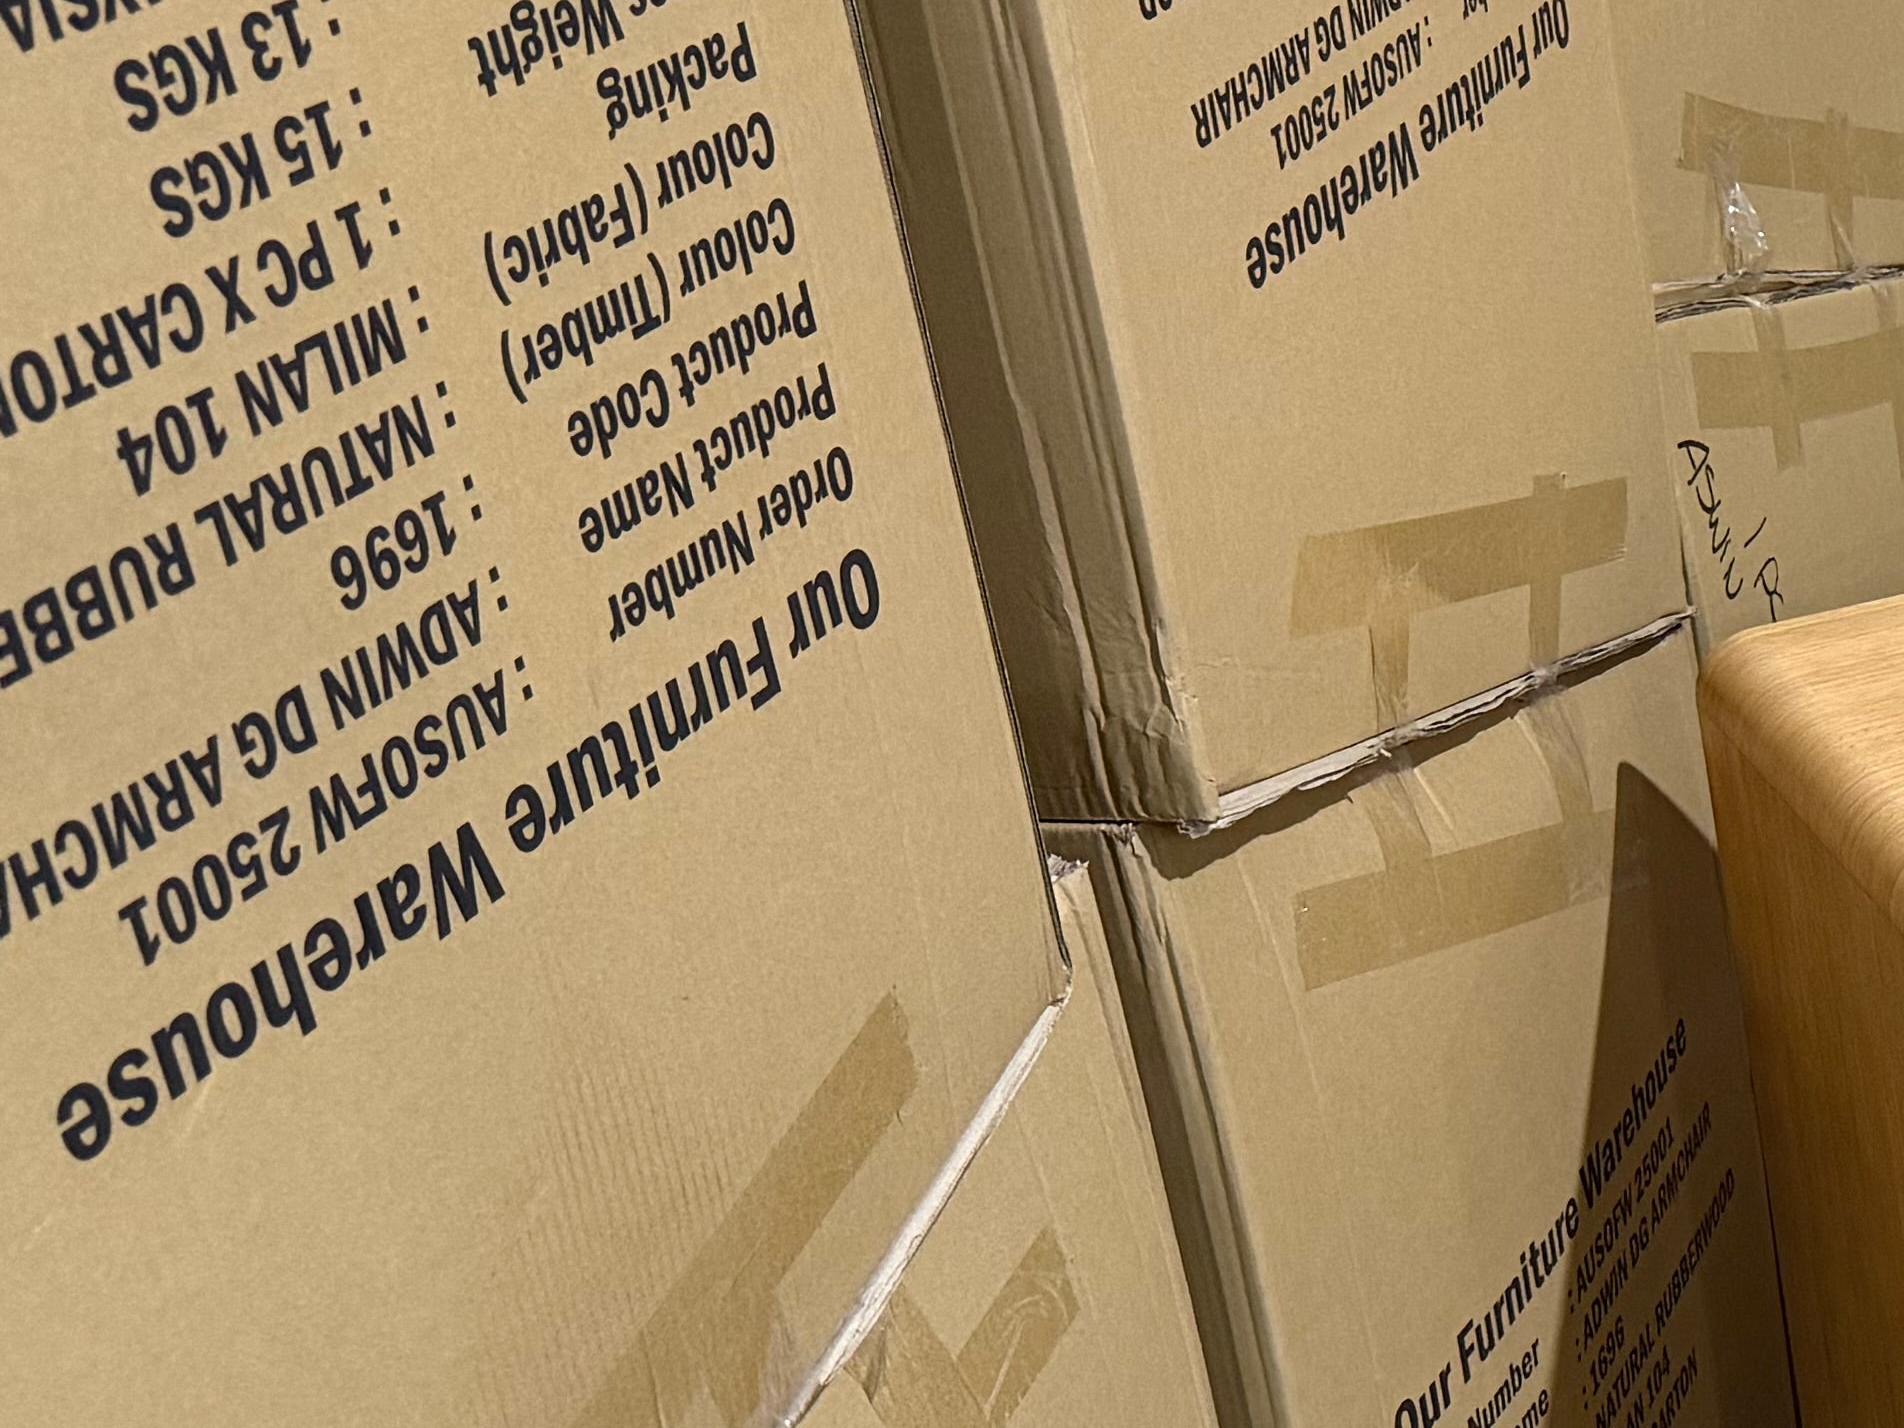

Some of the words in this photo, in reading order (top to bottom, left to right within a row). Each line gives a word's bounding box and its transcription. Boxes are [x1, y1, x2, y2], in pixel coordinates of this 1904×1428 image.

[1191, 26, 1309, 147] ARMCHAIR
[1313, 4, 1346, 62] DG
[1419, 23, 1531, 152] Furniture
[655, 111, 774, 207] Colour
[1245, 121, 1419, 288] Warehouse
[483, 161, 647, 305] (Fabric)
[234, 298, 405, 435] MILAN
[670, 279, 815, 405] Product
[116, 386, 226, 495] 104
[567, 368, 669, 459] Code
[329, 490, 455, 610] 1696
[758, 446, 852, 540] Order
[608, 510, 754, 642] Number
[787, 548, 878, 659] Our
[309, 668, 505, 853] AUSOFW
[503, 616, 780, 852] Furniture
[117, 805, 300, 966] 25001
[55, 822, 503, 1161] Warehouse
[1457, 1197, 1578, 1384] Furniture
[1579, 1019, 1686, 1210] Warehouse
[1576, 1181, 1632, 1303] AUSOFW
[1634, 1114, 1673, 1204] 25001
[1646, 1344, 1670, 1409] 104
